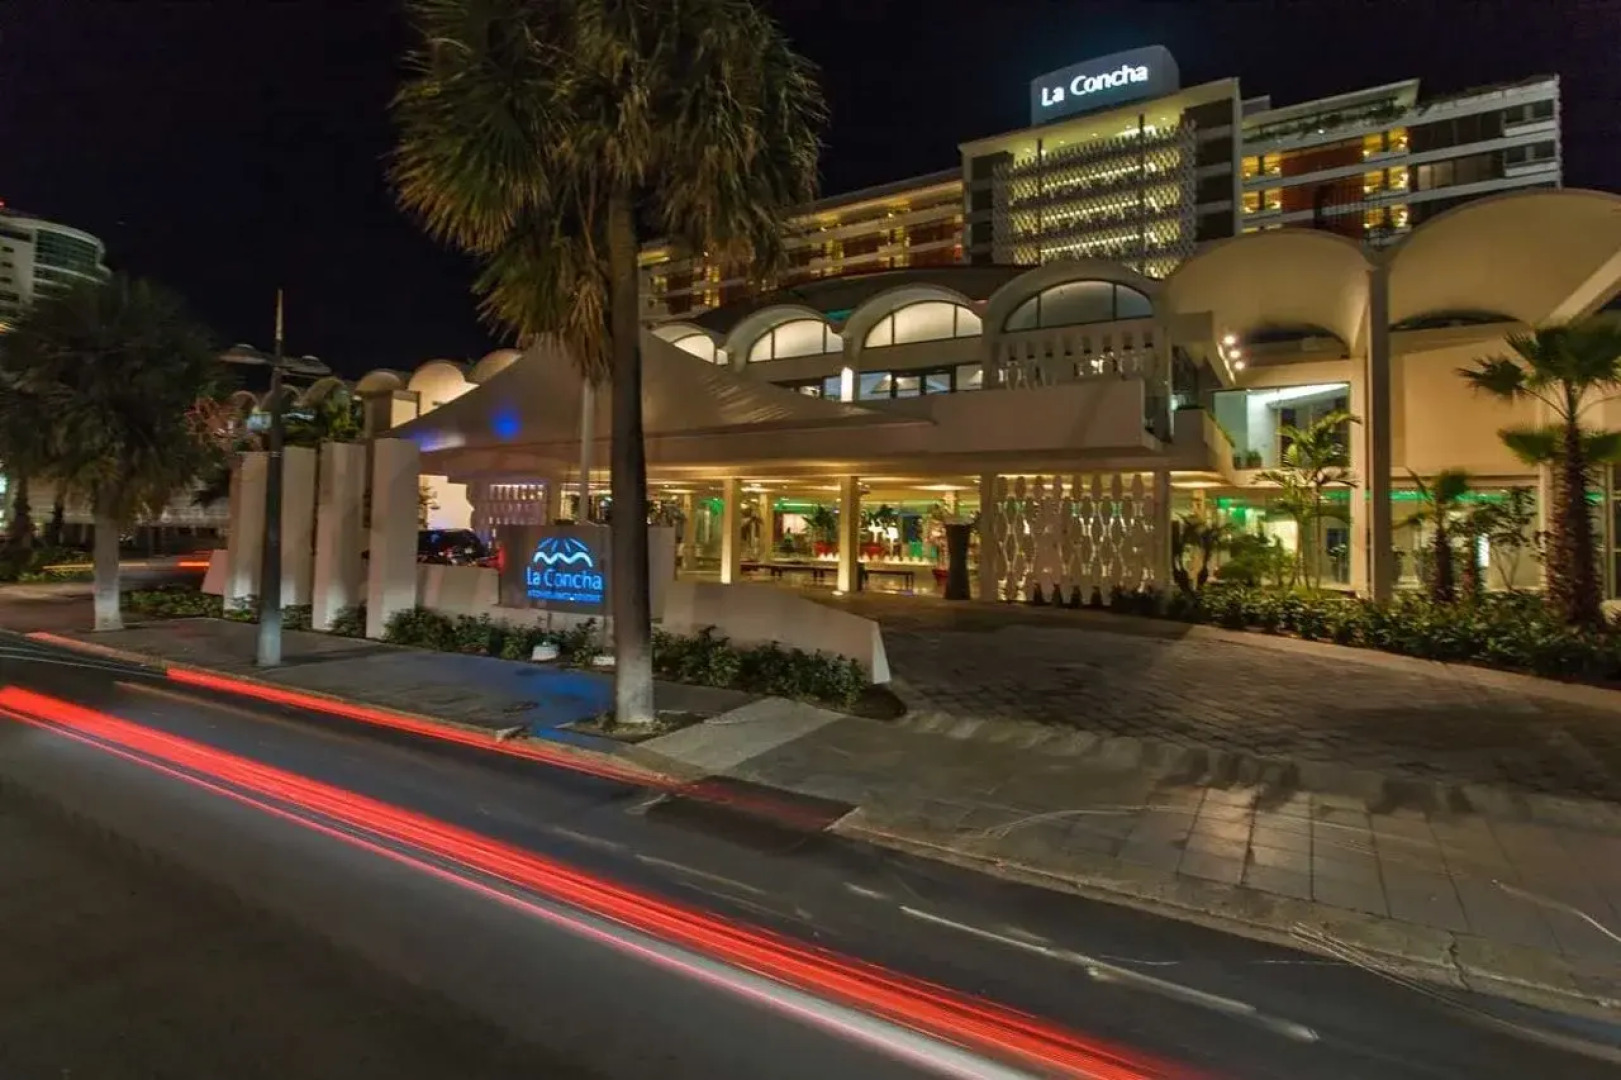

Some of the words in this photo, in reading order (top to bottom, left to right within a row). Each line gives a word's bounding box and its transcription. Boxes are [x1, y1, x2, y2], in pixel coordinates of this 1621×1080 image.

[1041, 87, 1064, 106] La
[1071, 65, 1148, 95] Concha
[527, 566, 541, 586] La
[544, 568, 602, 590] Concha
